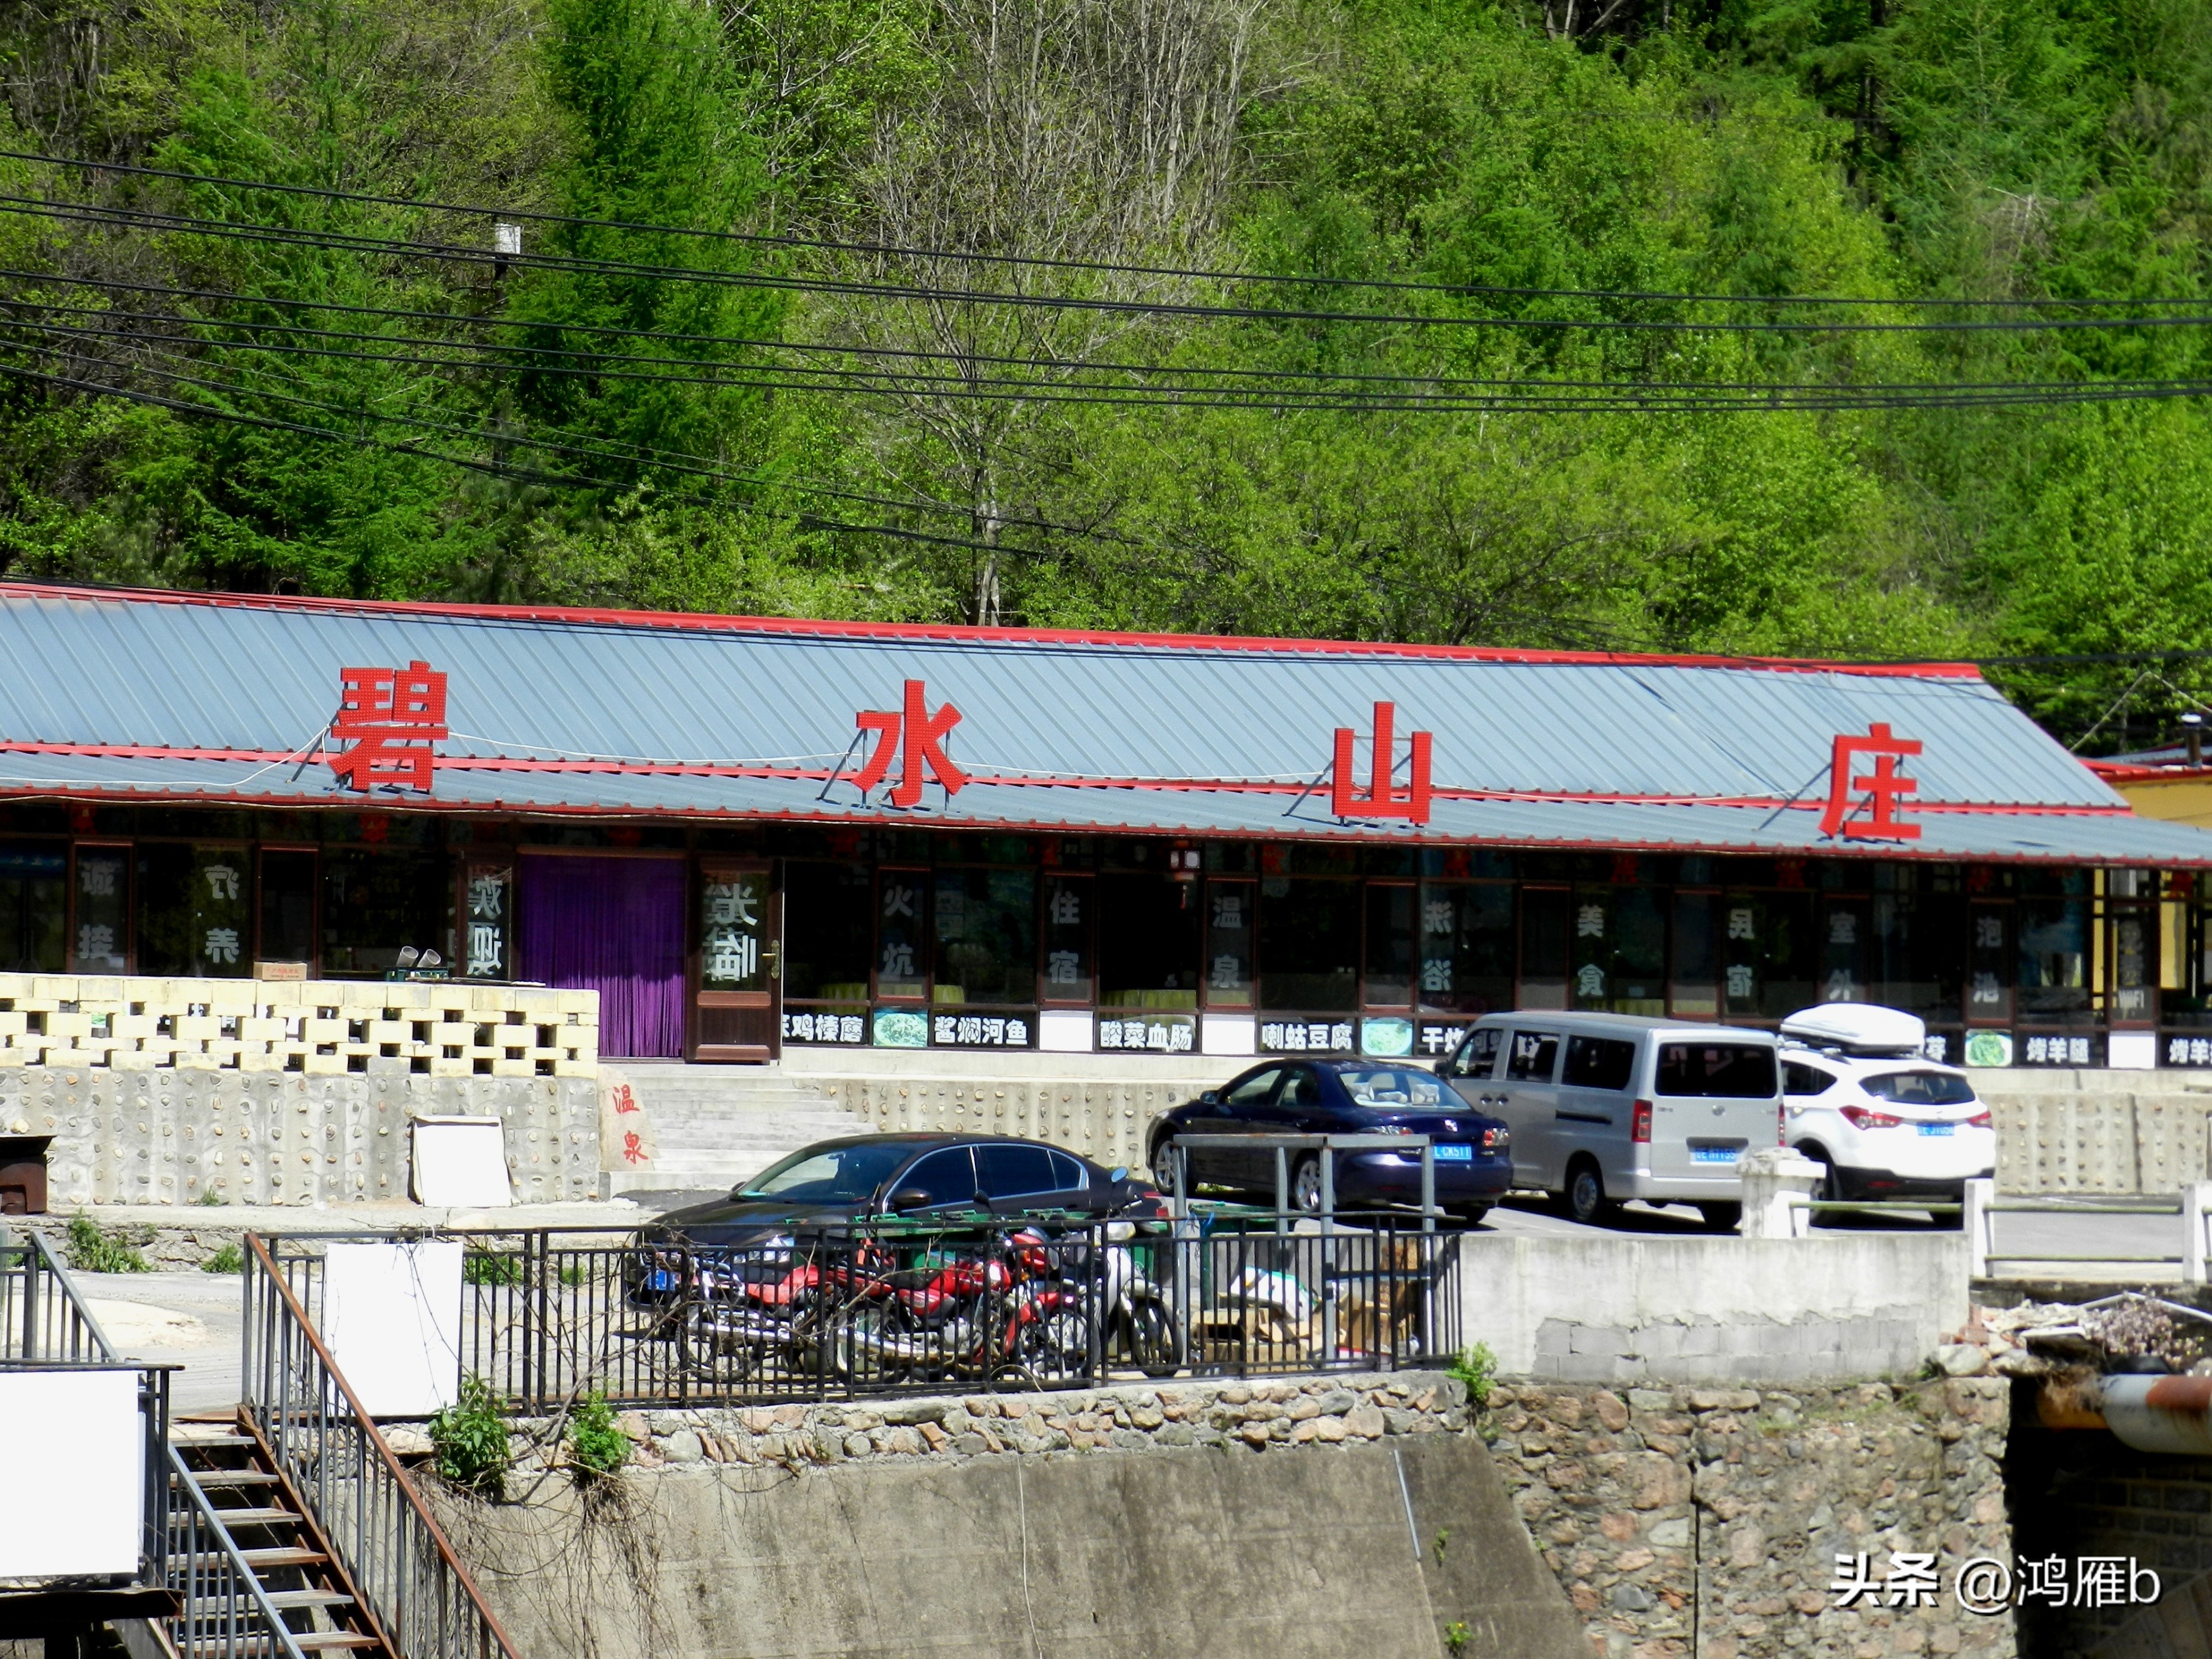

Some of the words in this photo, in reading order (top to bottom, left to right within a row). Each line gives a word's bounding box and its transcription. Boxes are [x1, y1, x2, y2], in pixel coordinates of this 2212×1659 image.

[327, 660, 1923, 839] 碧水山庄
[884, 884, 913, 981] 火炕
[1050, 890, 1080, 984] 住宿
[1213, 896, 1242, 989] 温泉
[1829, 911, 1856, 1000] 室外
[1973, 916, 2003, 1003] 泡池
[934, 1015, 1028, 1045] 酱焖河鱼
[1100, 1020, 1193, 1052] 酸菜血肠
[1261, 1022, 1352, 1050] 喇蛄豆腐
[2169, 1038, 2212, 1064] 烤羊
[612, 1084, 648, 1164] 温泉
